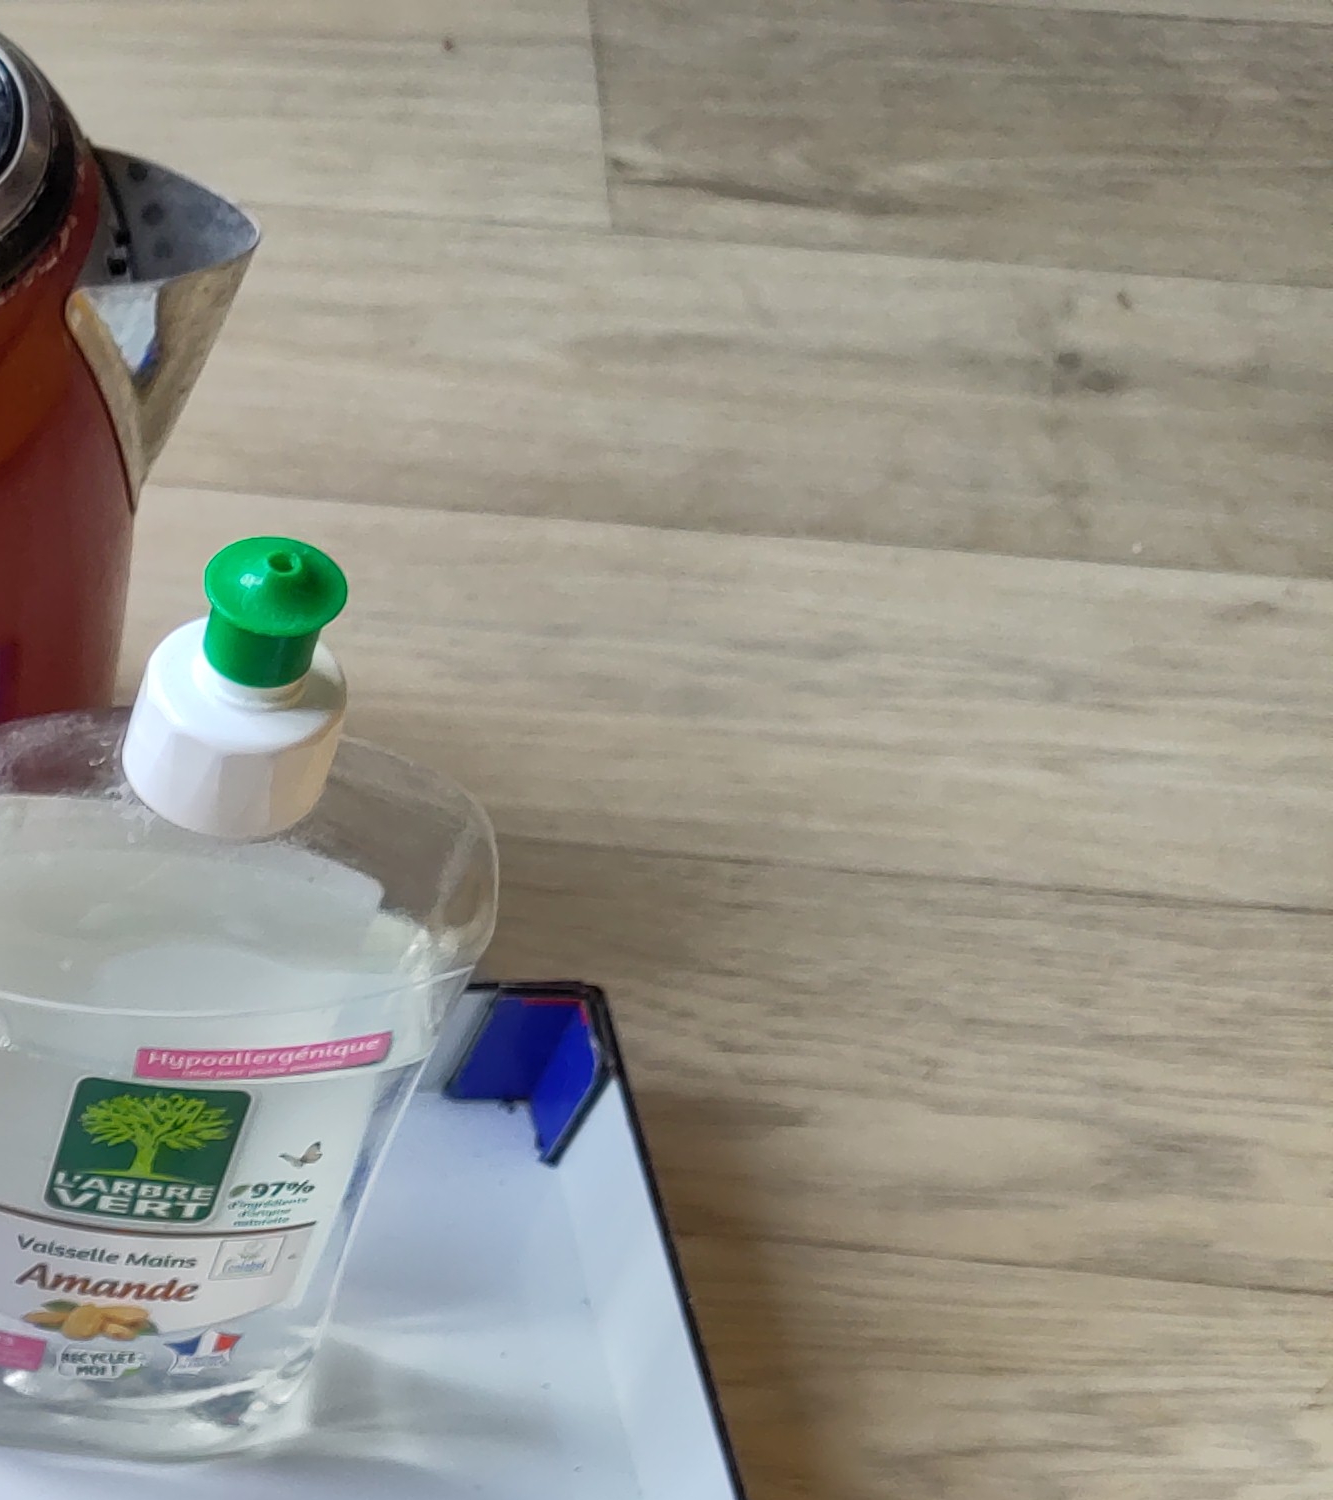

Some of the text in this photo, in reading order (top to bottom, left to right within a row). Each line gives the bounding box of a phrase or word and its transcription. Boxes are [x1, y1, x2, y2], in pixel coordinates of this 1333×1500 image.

[147, 1038, 379, 1071] Hypoallergénique
[53, 1170, 216, 1201] L'ARBRE
[250, 1180, 316, 1199] 97%
[53, 1187, 210, 1219] VERT
[17, 1234, 198, 1269] Vaisselle Mains
[14, 1262, 201, 1302] Amande
